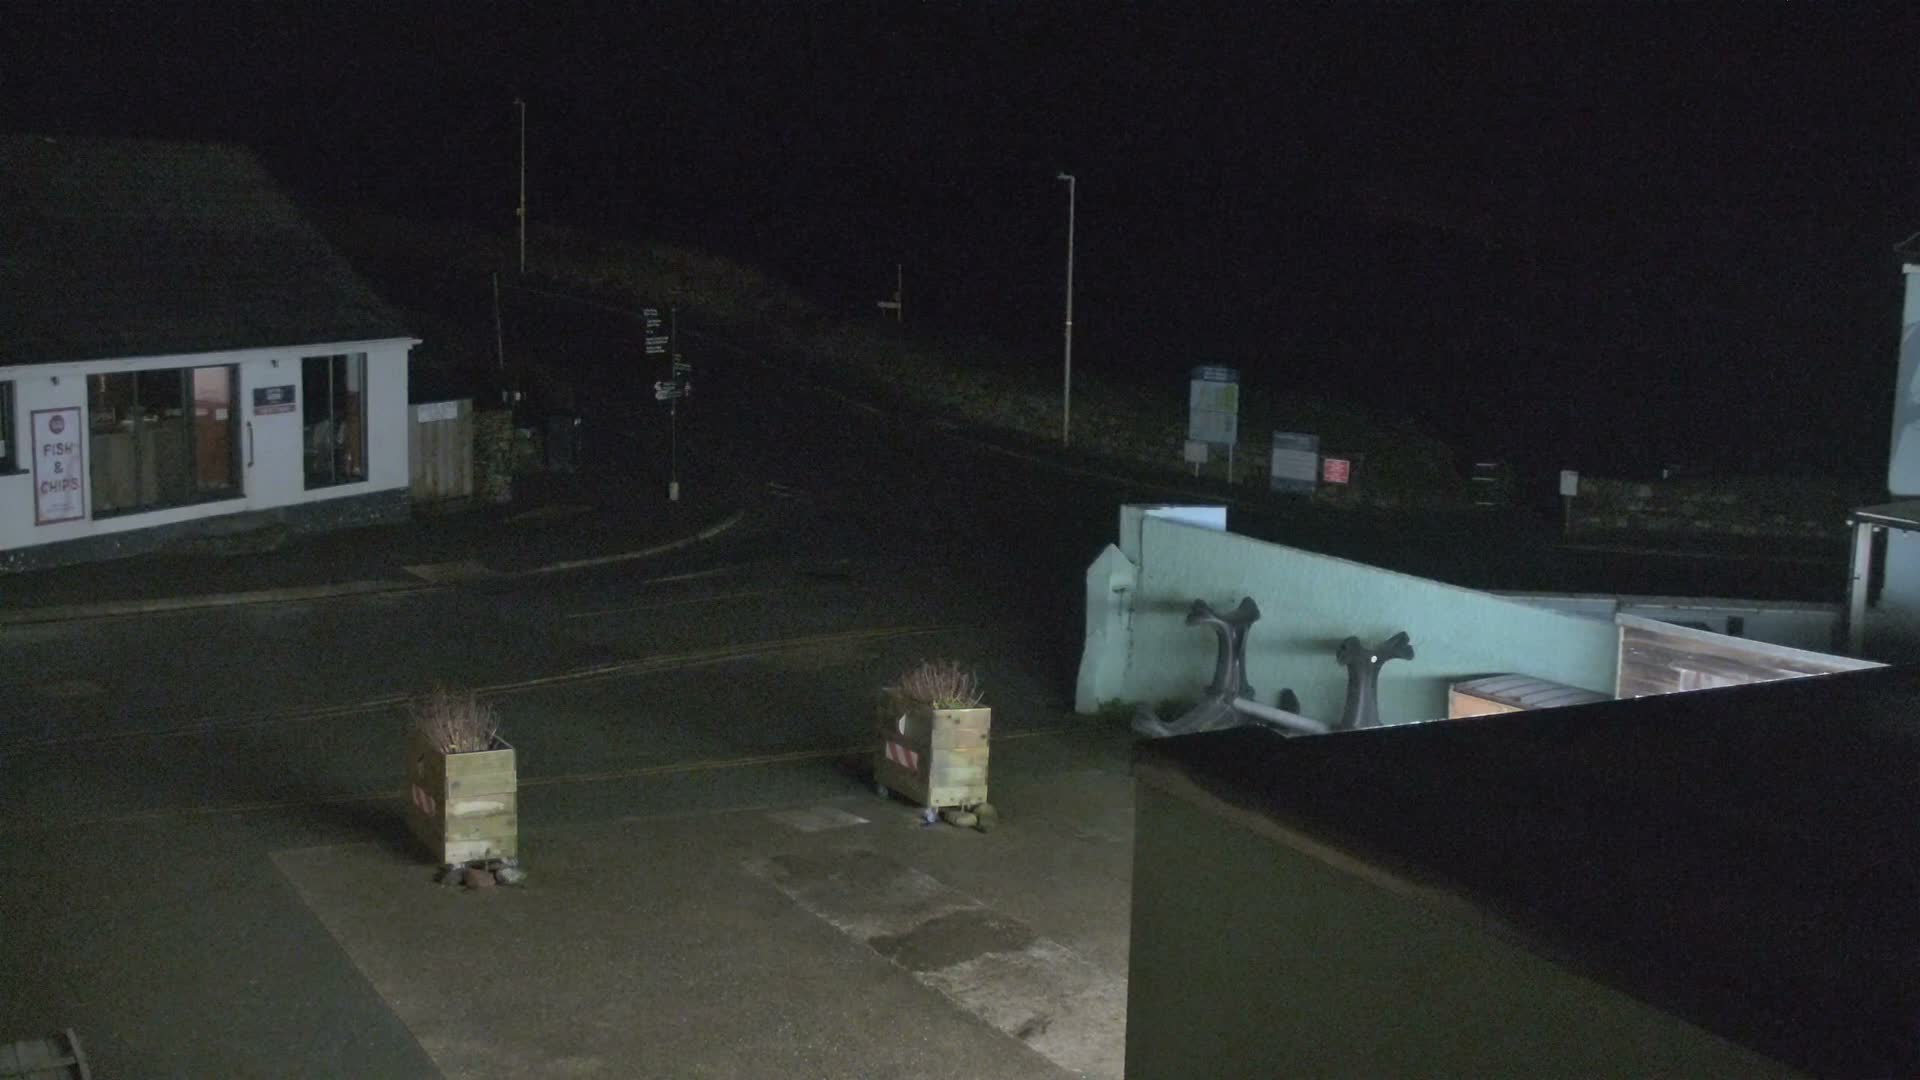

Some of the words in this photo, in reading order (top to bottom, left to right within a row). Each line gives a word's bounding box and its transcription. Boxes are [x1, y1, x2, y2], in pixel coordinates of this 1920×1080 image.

[43, 441, 73, 456] FISH
[54, 461, 63, 474] &
[41, 478, 79, 494] CHIPS
